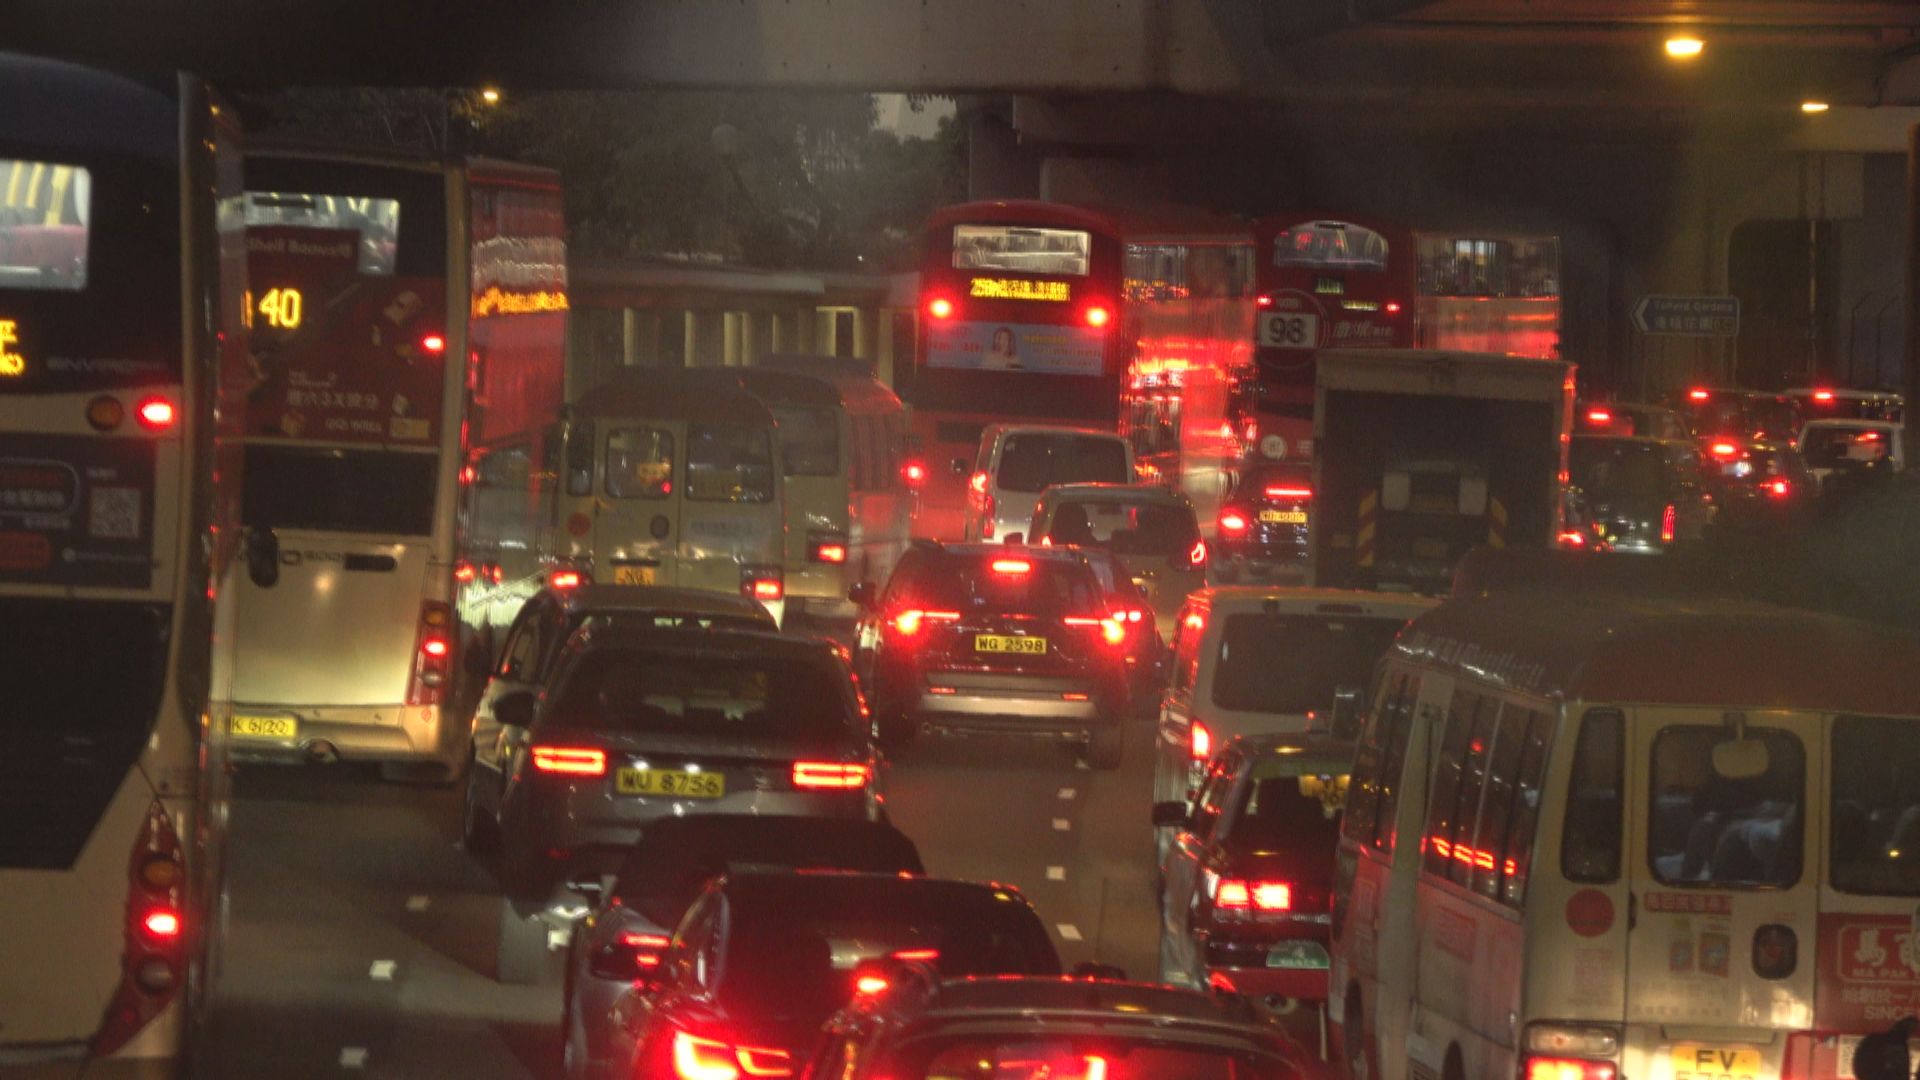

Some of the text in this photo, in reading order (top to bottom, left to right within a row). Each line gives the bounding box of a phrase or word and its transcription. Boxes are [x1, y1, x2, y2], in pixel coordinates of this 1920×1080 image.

[1269, 315, 1314, 344] 98
[978, 637, 1043, 652] WG 2598
[622, 772, 720, 794] WU 8756
